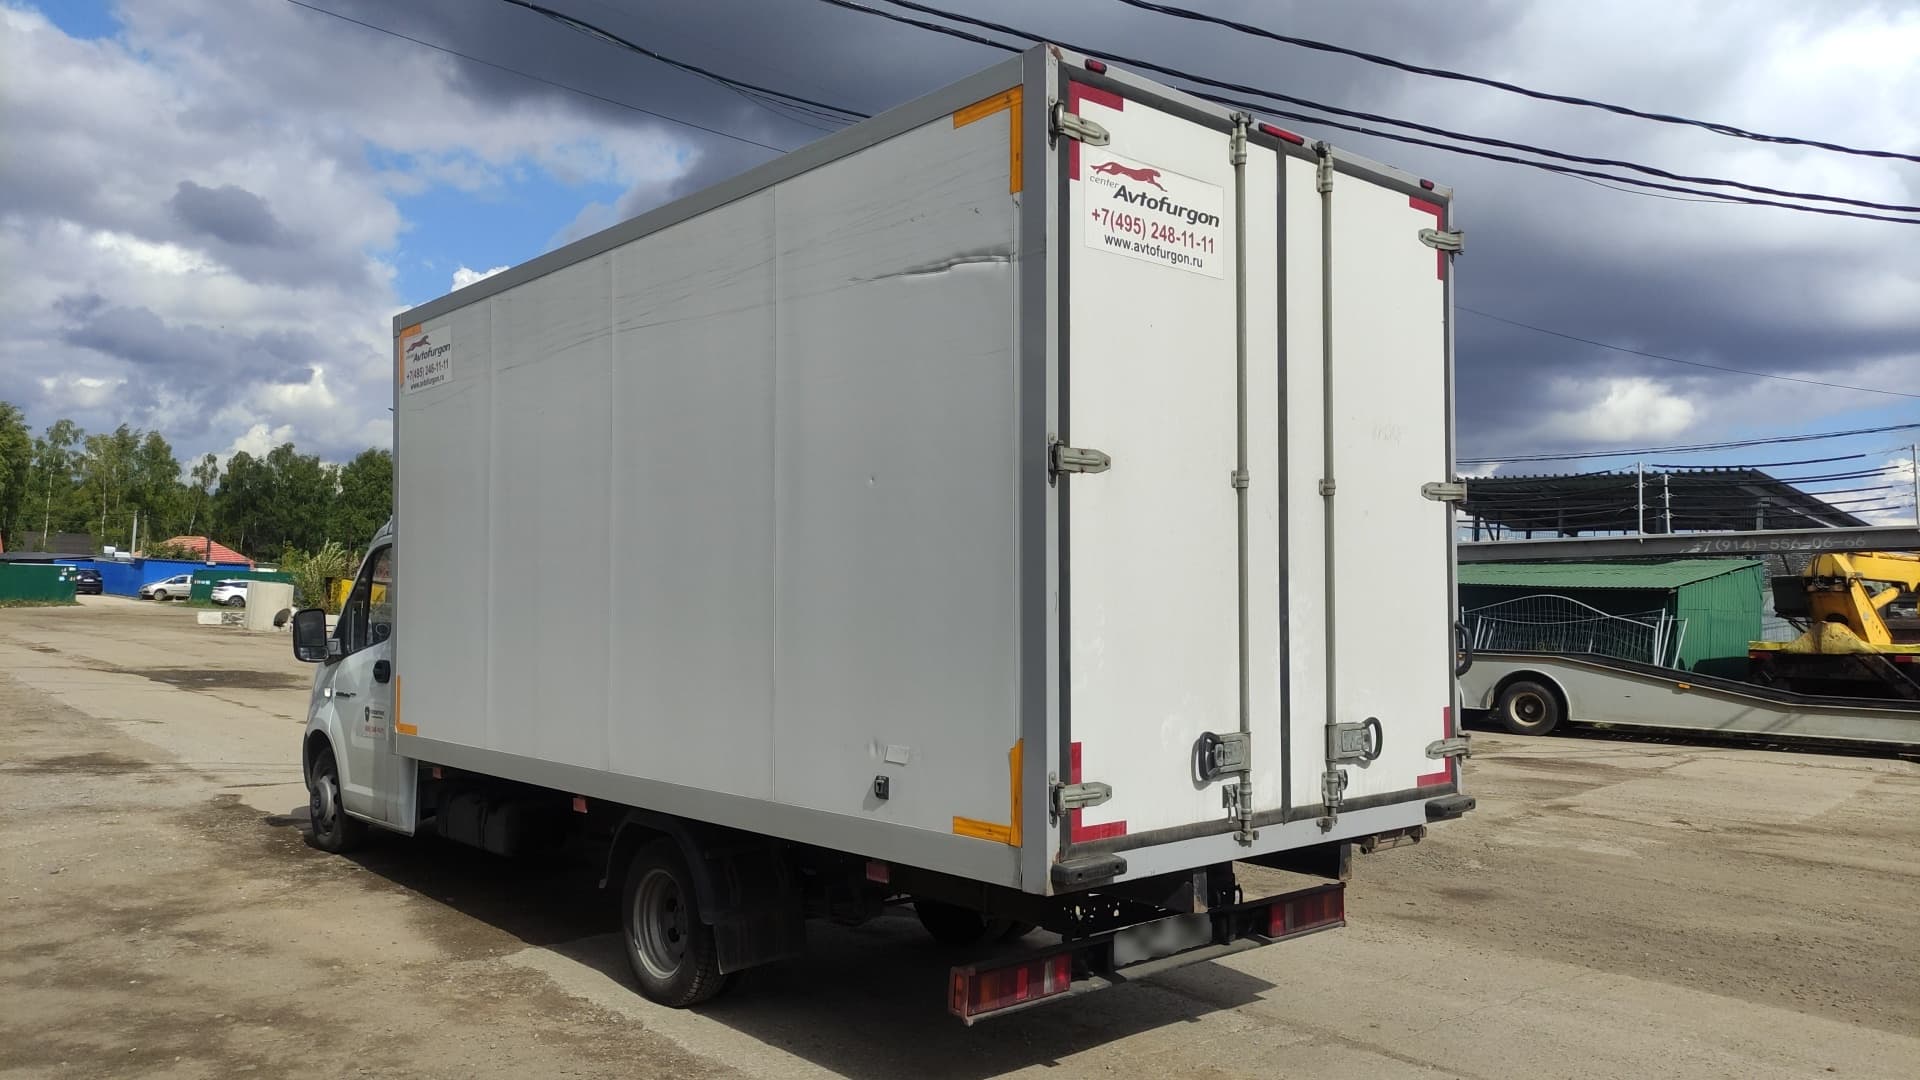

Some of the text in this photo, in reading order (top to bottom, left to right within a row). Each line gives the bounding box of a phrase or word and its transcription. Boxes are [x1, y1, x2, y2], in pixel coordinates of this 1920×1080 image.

[1089, 175, 1119, 189] center
[1113, 185, 1220, 228] Avtofurgon
[1091, 207, 1214, 254] +7(495) 248-11-11
[1104, 234, 1203, 268] www.avtofurgon.ru
[413, 343, 451, 363] Avtofurgon
